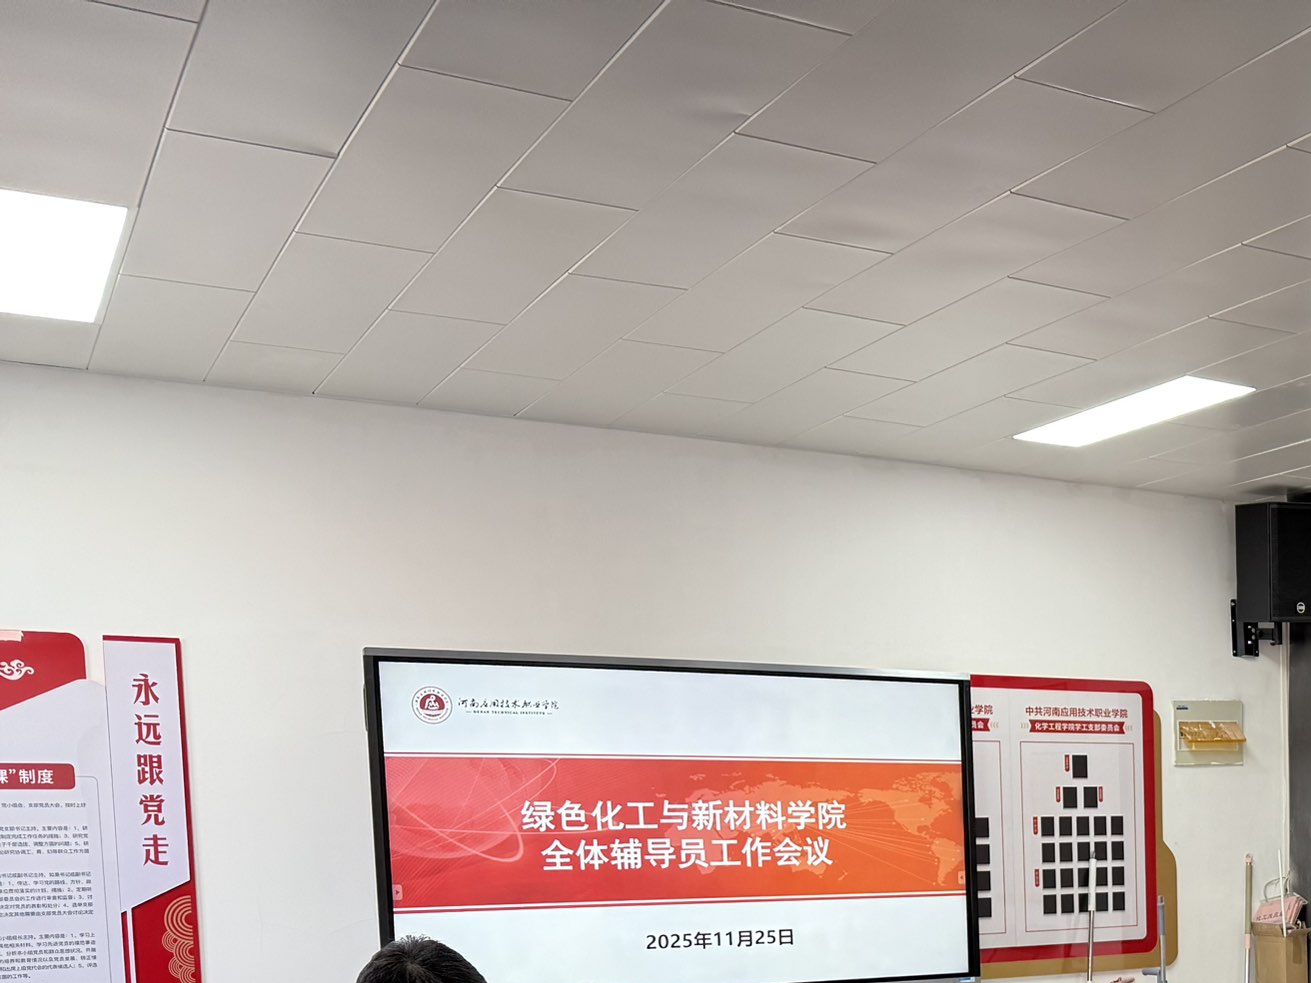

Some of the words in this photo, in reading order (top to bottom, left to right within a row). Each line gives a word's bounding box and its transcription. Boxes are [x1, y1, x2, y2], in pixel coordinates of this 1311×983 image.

[1025, 706, 1128, 719] 中共河南应用技术职业学院
[1034, 722, 1120, 732] 化学工程学院学工支部委员会
[132, 673, 169, 866] 永远跟党走
[521, 799, 847, 832] 绿色化工与新材料学院
[540, 836, 833, 871] 全体辅导员工作会议
[646, 928, 795, 950] 2025年11月25日
